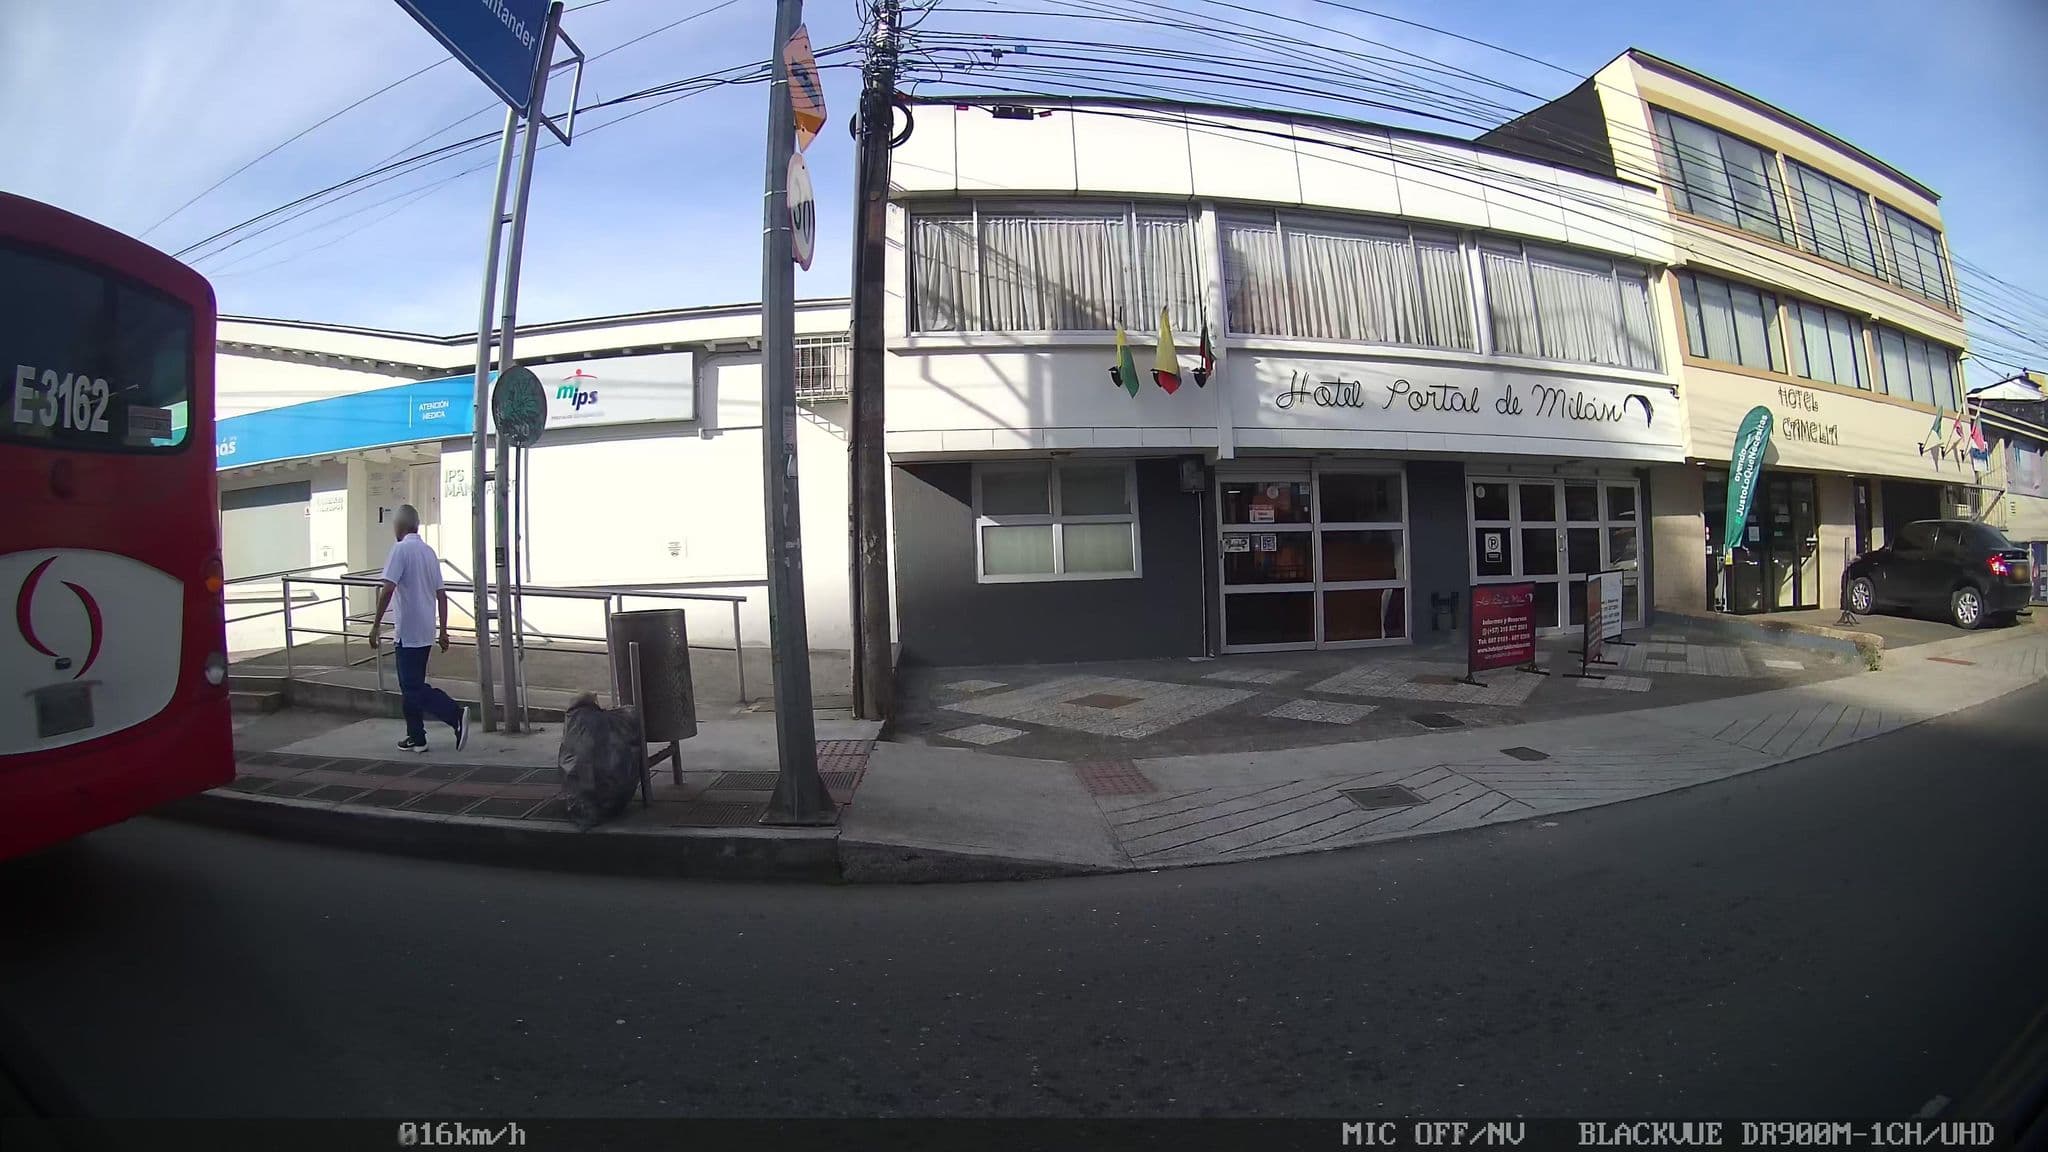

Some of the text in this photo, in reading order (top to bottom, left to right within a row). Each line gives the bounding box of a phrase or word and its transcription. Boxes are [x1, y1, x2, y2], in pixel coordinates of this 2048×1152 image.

[556, 384, 598, 411] mips
[1276, 369, 1622, 422] Hotel Portal de Milán
[1778, 386, 1819, 412] HOTEL
